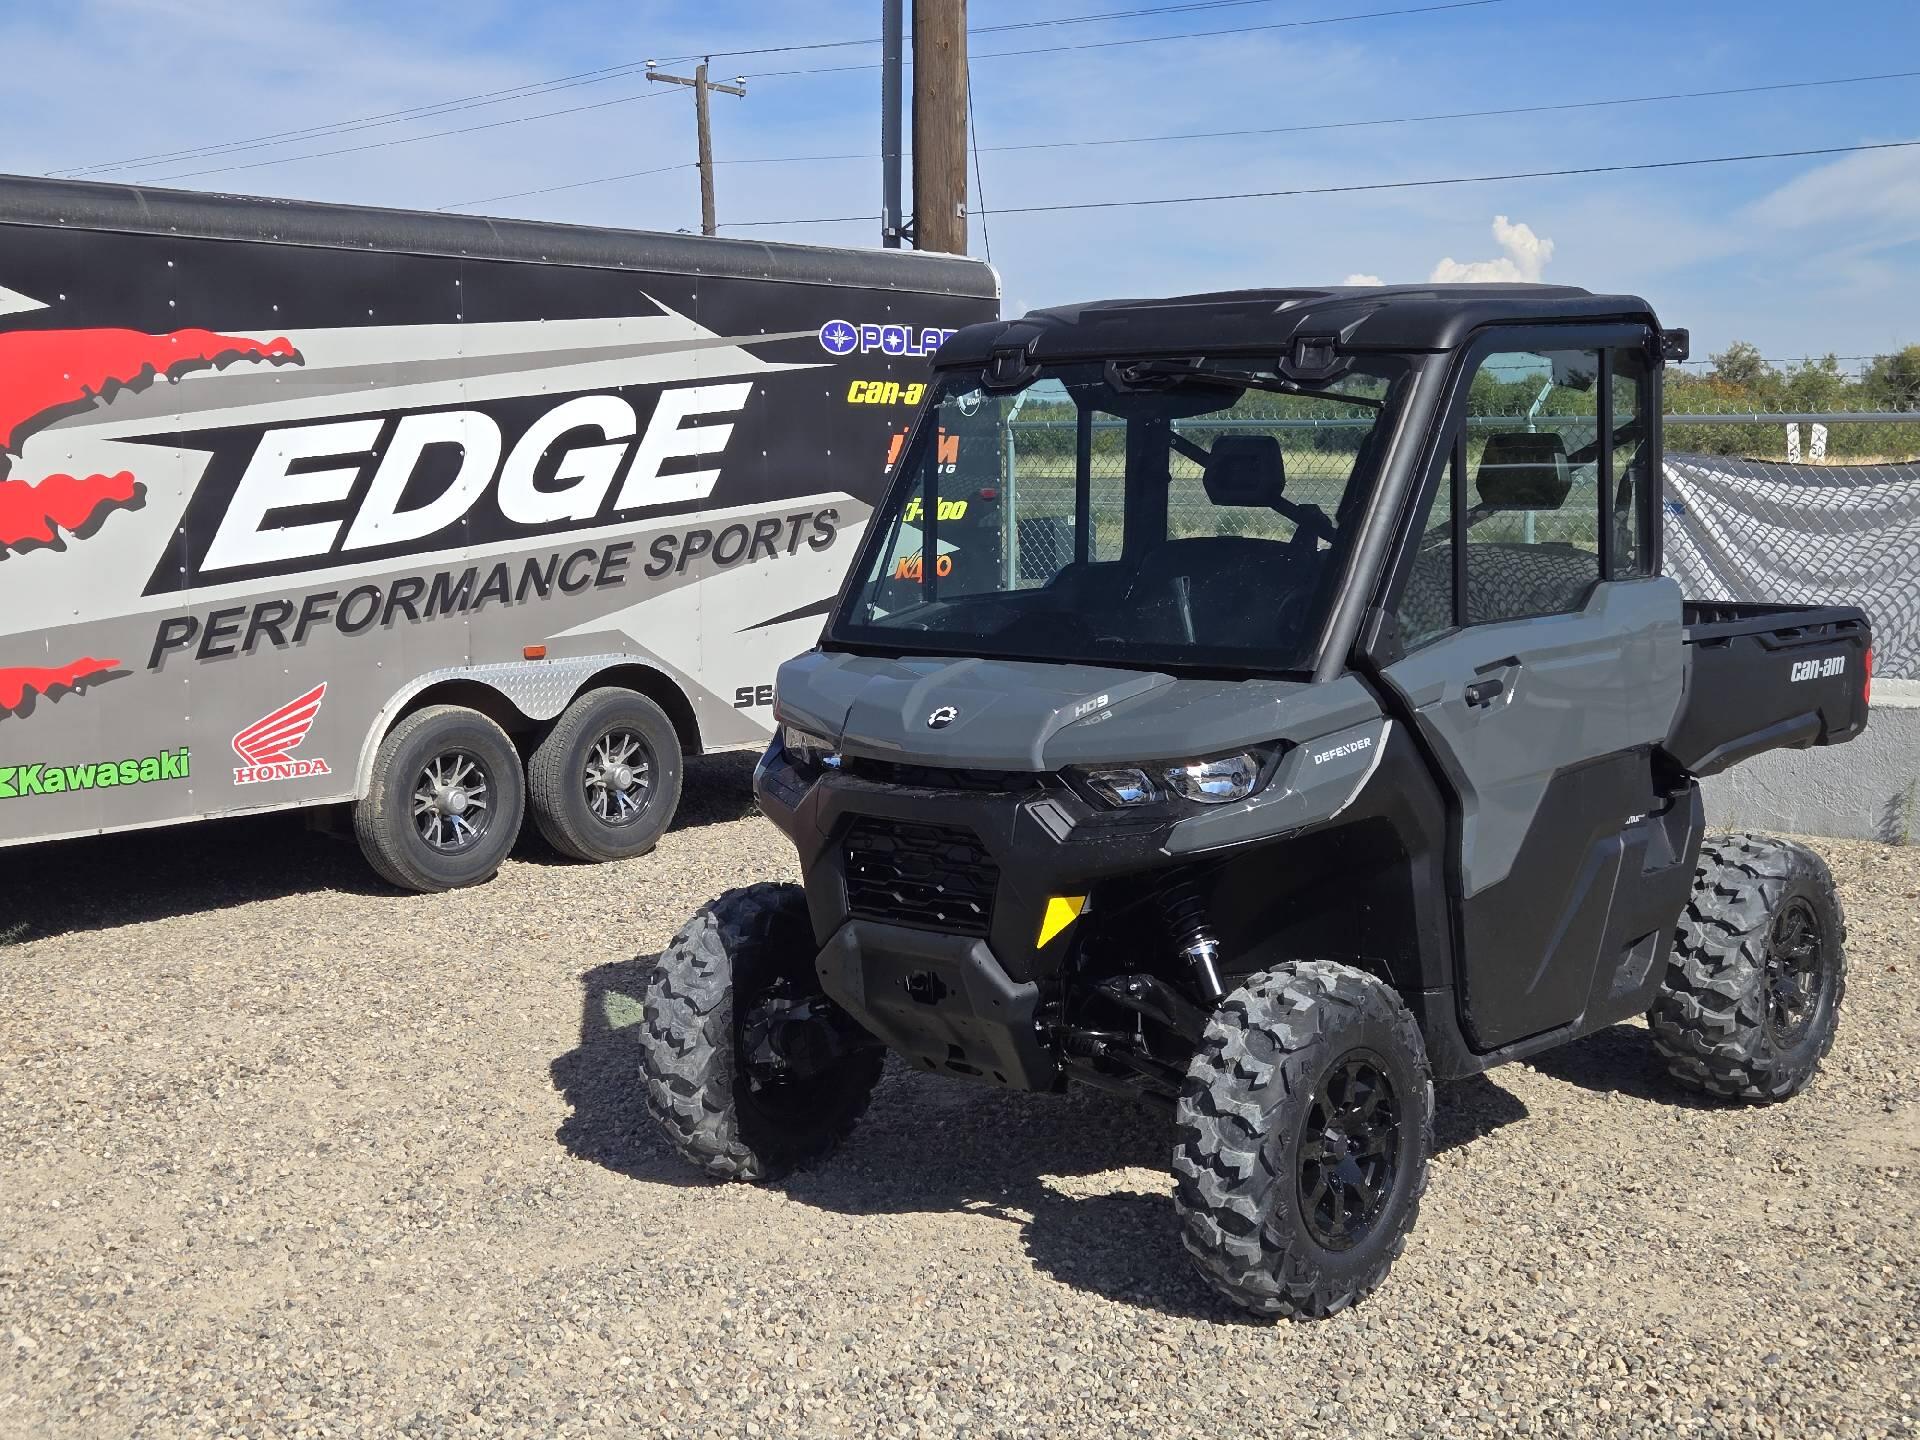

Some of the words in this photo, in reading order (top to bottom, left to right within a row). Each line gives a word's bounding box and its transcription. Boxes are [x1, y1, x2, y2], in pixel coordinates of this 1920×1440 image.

[847, 381, 928, 404] can-a
[198, 382, 754, 573] EDGE
[146, 541, 637, 673] PERFORMANCE
[643, 508, 841, 580] SPORTS
[1790, 655, 1846, 682] can-am
[1075, 694, 1109, 717] HD9
[1313, 737, 1372, 765] DEFENDER
[17, 746, 189, 796] Kawasaki
[233, 758, 333, 785] HONDA
